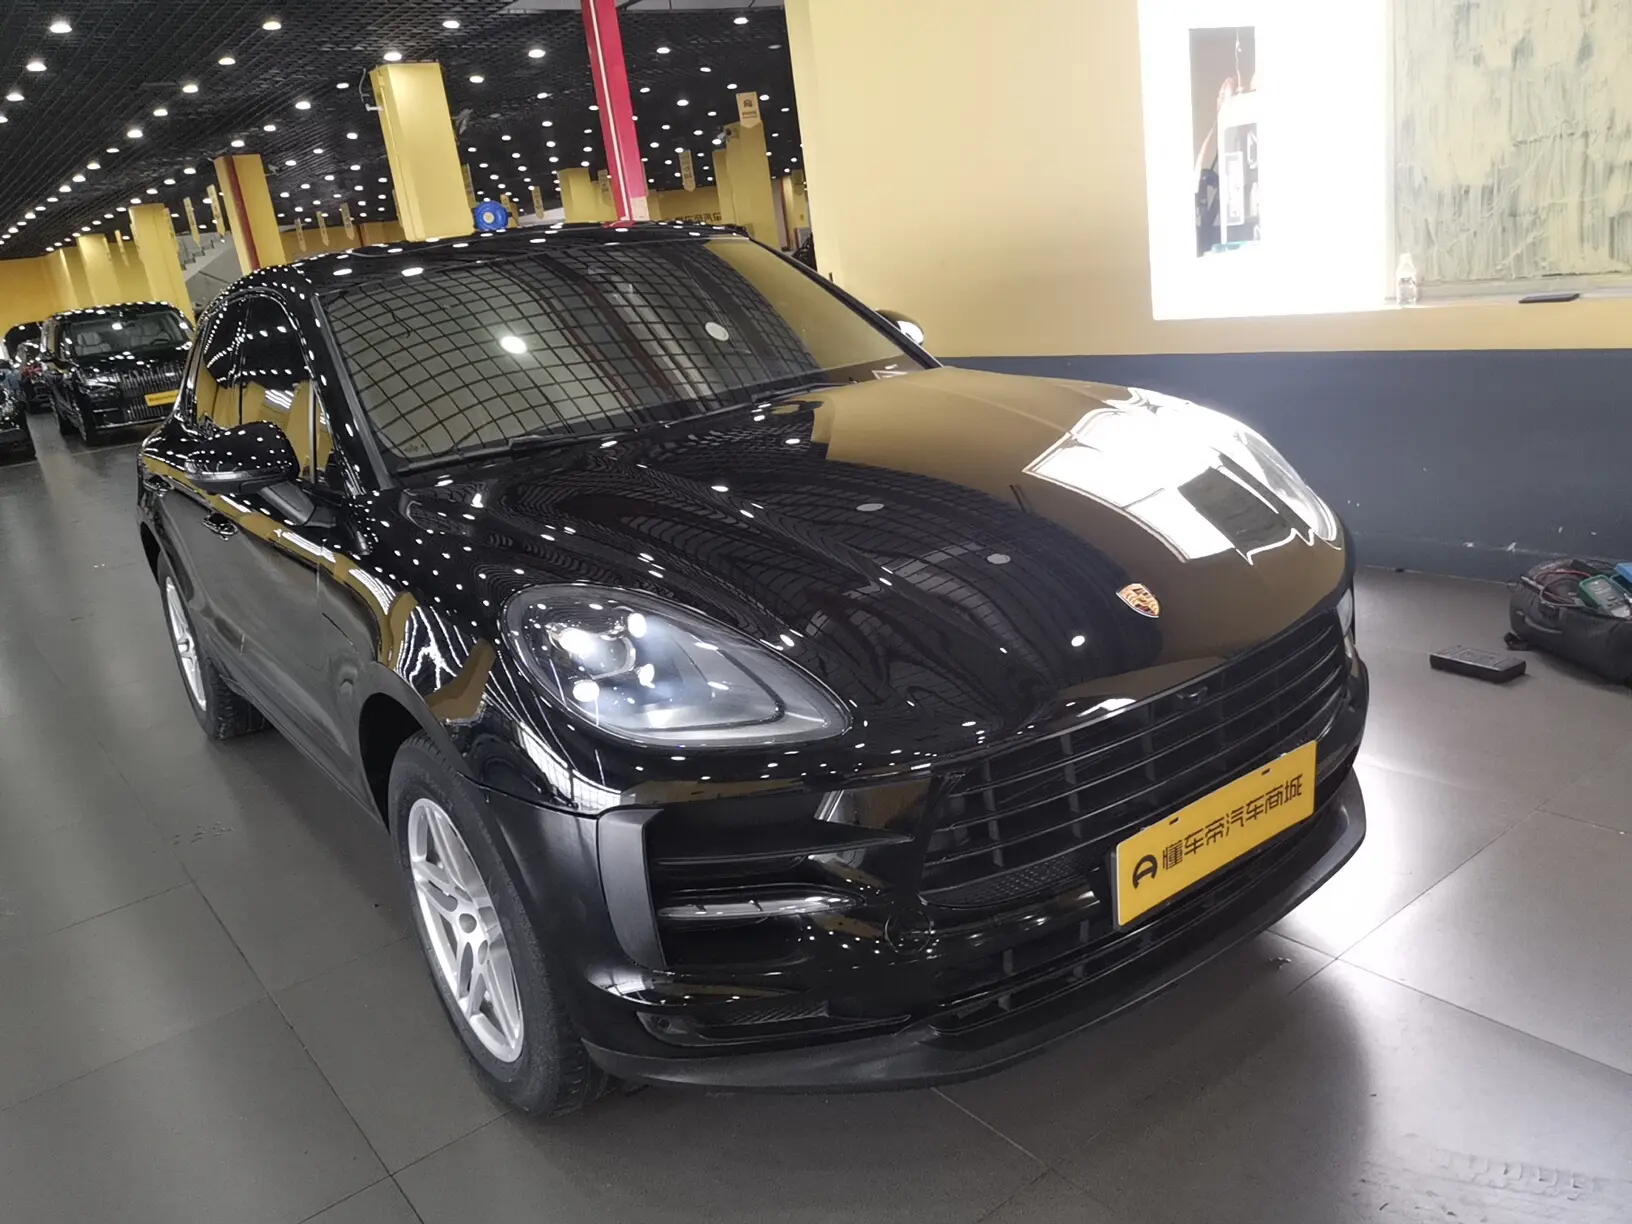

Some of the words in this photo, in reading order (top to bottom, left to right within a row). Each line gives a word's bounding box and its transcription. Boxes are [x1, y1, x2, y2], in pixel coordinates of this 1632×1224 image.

[1162, 773, 1303, 870] 懂车帝汽车商城
